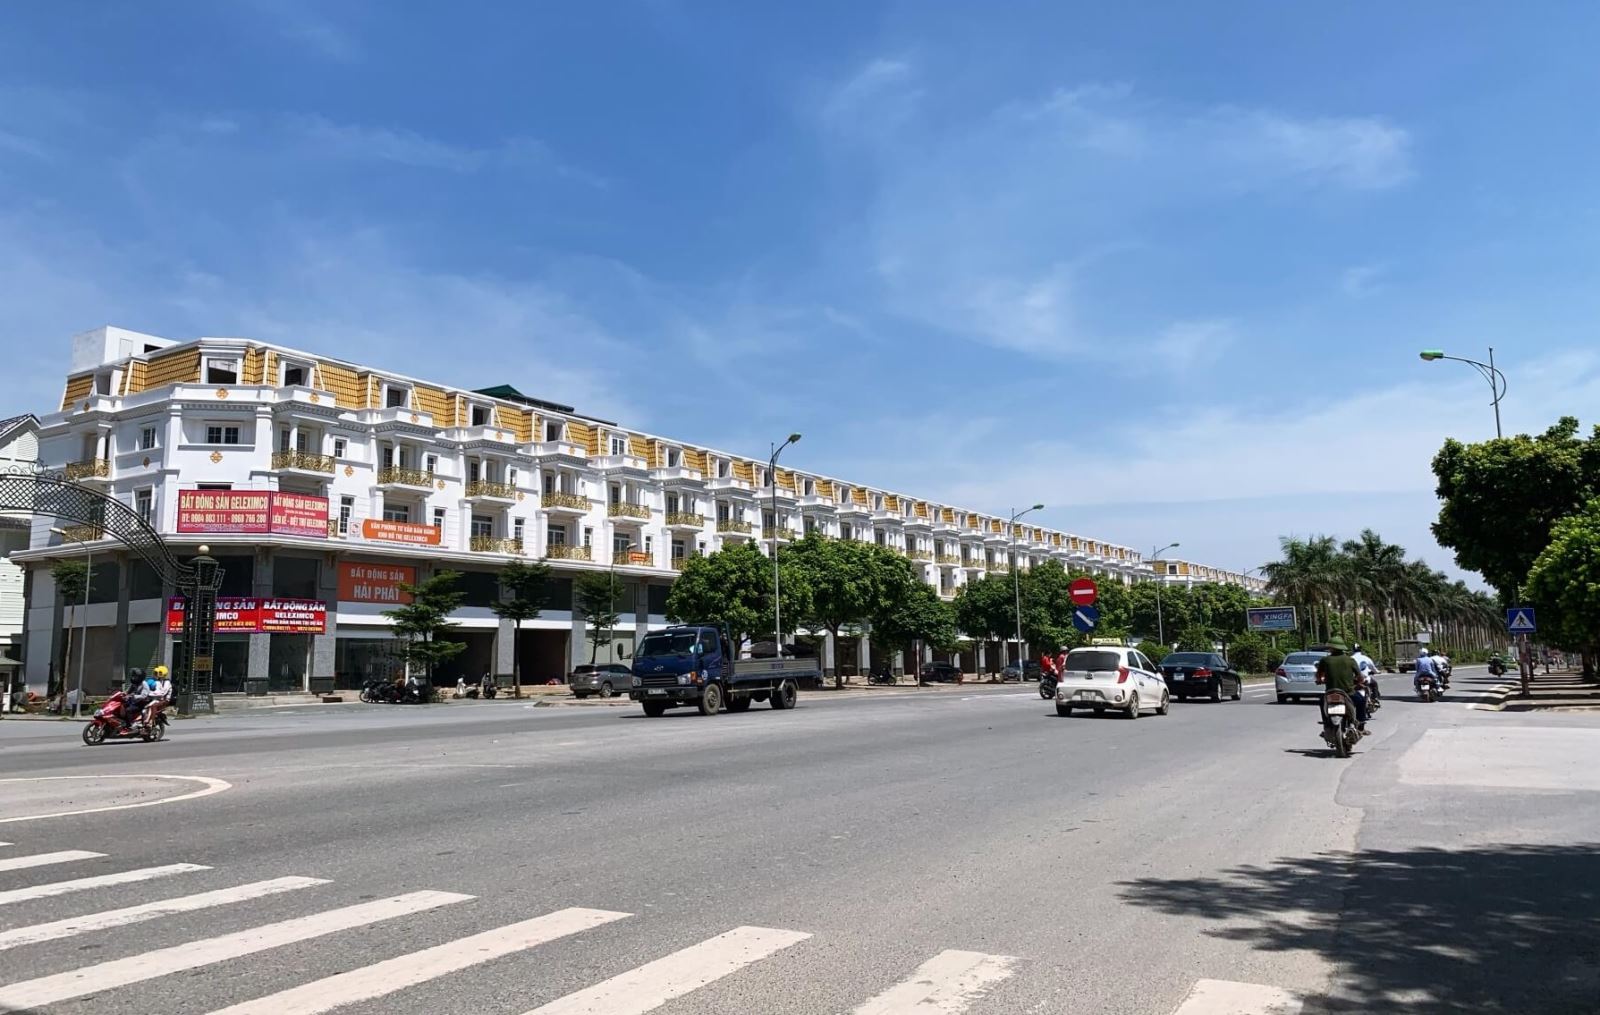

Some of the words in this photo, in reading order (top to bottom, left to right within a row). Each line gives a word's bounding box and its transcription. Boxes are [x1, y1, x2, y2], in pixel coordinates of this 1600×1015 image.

[181, 492, 194, 509] BẤT
[195, 493, 214, 510] ĐỘNG
[215, 492, 230, 509] SẢN
[231, 496, 269, 510] GELEXIMCO
[350, 567, 366, 578] BẤT
[367, 568, 388, 581] ĐỘNG
[389, 569, 405, 581] SẢN
[353, 581, 373, 600] HẢI
[374, 584, 401, 601] PHÁT
[232, 598, 256, 610] SẢN
[263, 600, 283, 610] BẤT
[283, 600, 308, 612] ĐỘNG
[309, 602, 326, 612] SẢN
[274, 611, 315, 619] GELEXIMCO
